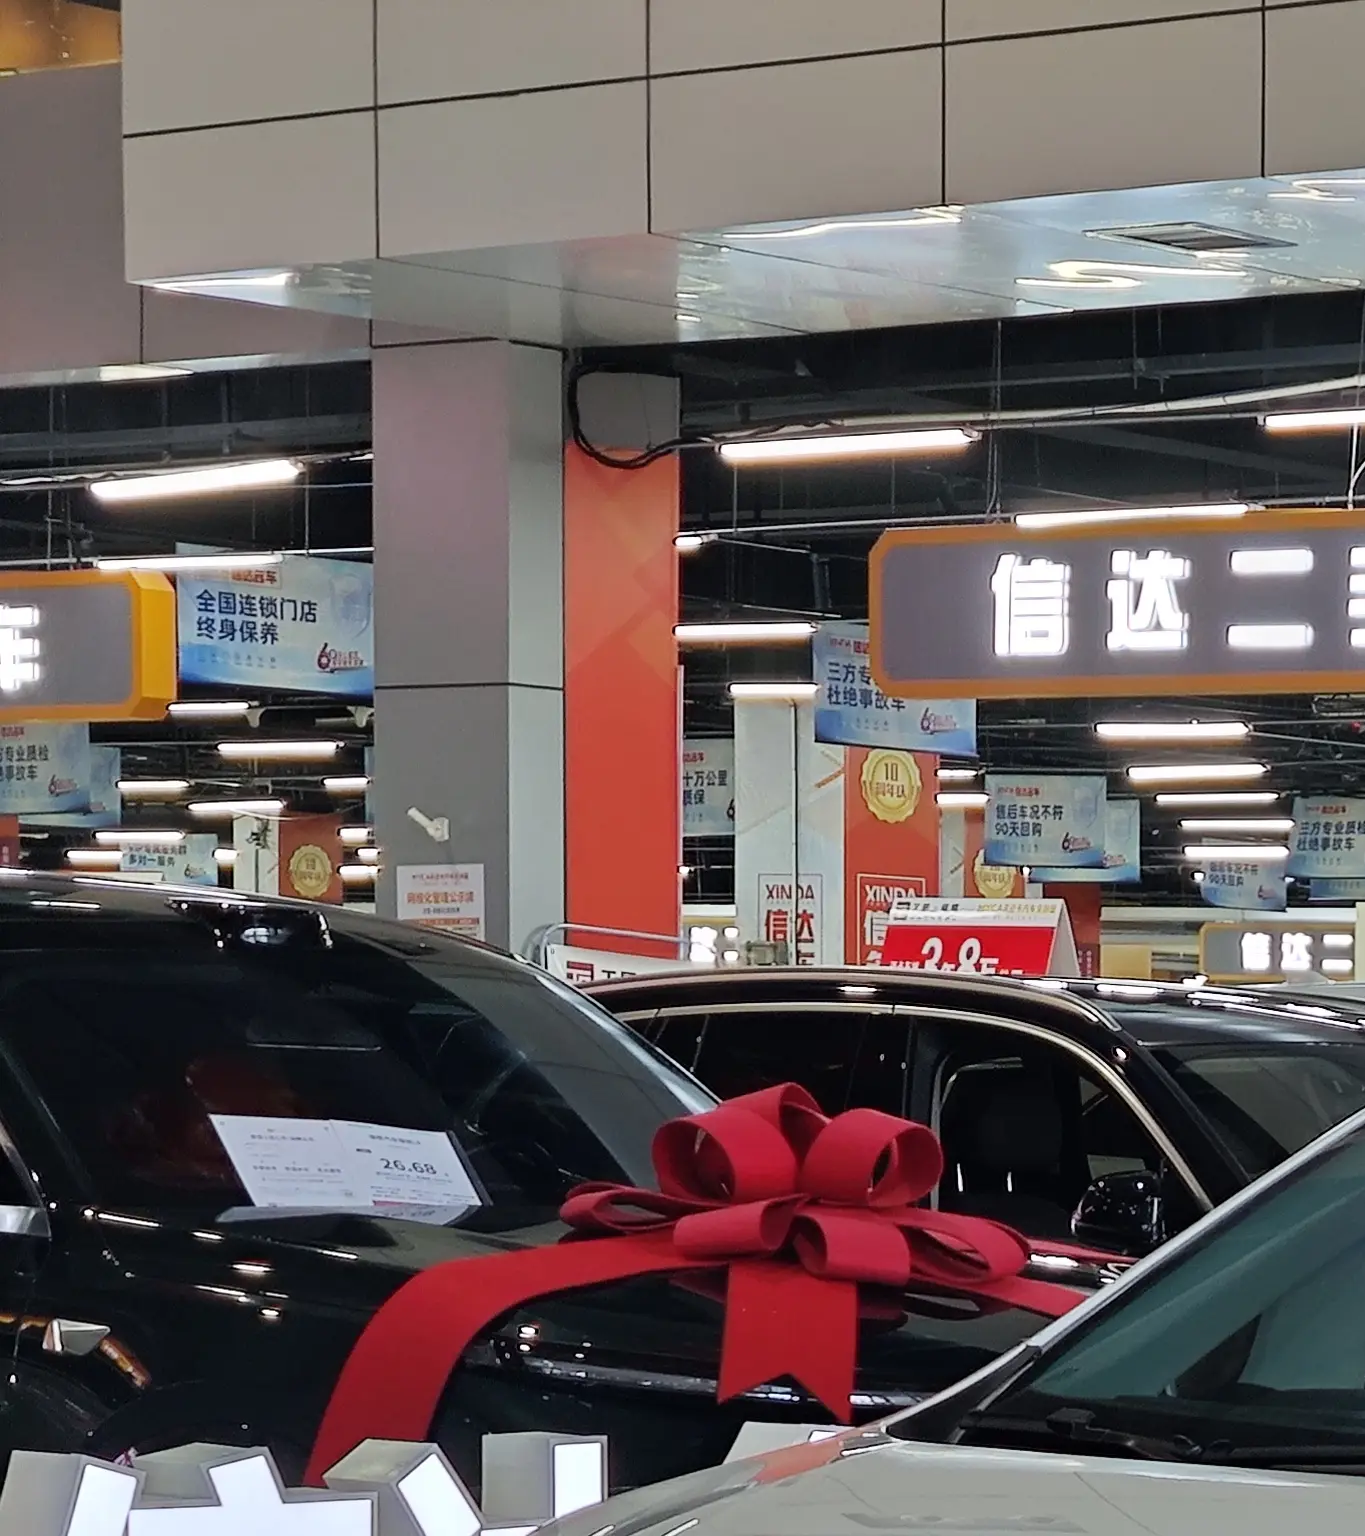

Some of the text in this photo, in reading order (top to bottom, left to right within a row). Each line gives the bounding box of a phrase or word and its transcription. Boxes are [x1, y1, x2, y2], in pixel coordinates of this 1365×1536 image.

[196, 588, 318, 624] 全国连锁门店
[196, 615, 280, 646] 终身保养
[0, 743, 49, 763] 专业质检
[995, 803, 1065, 821] 售后车况不符
[994, 821, 1043, 837] 90天回购
[1295, 837, 1356, 852] 杜绝事故车
[379, 1157, 438, 1176] 26.68
